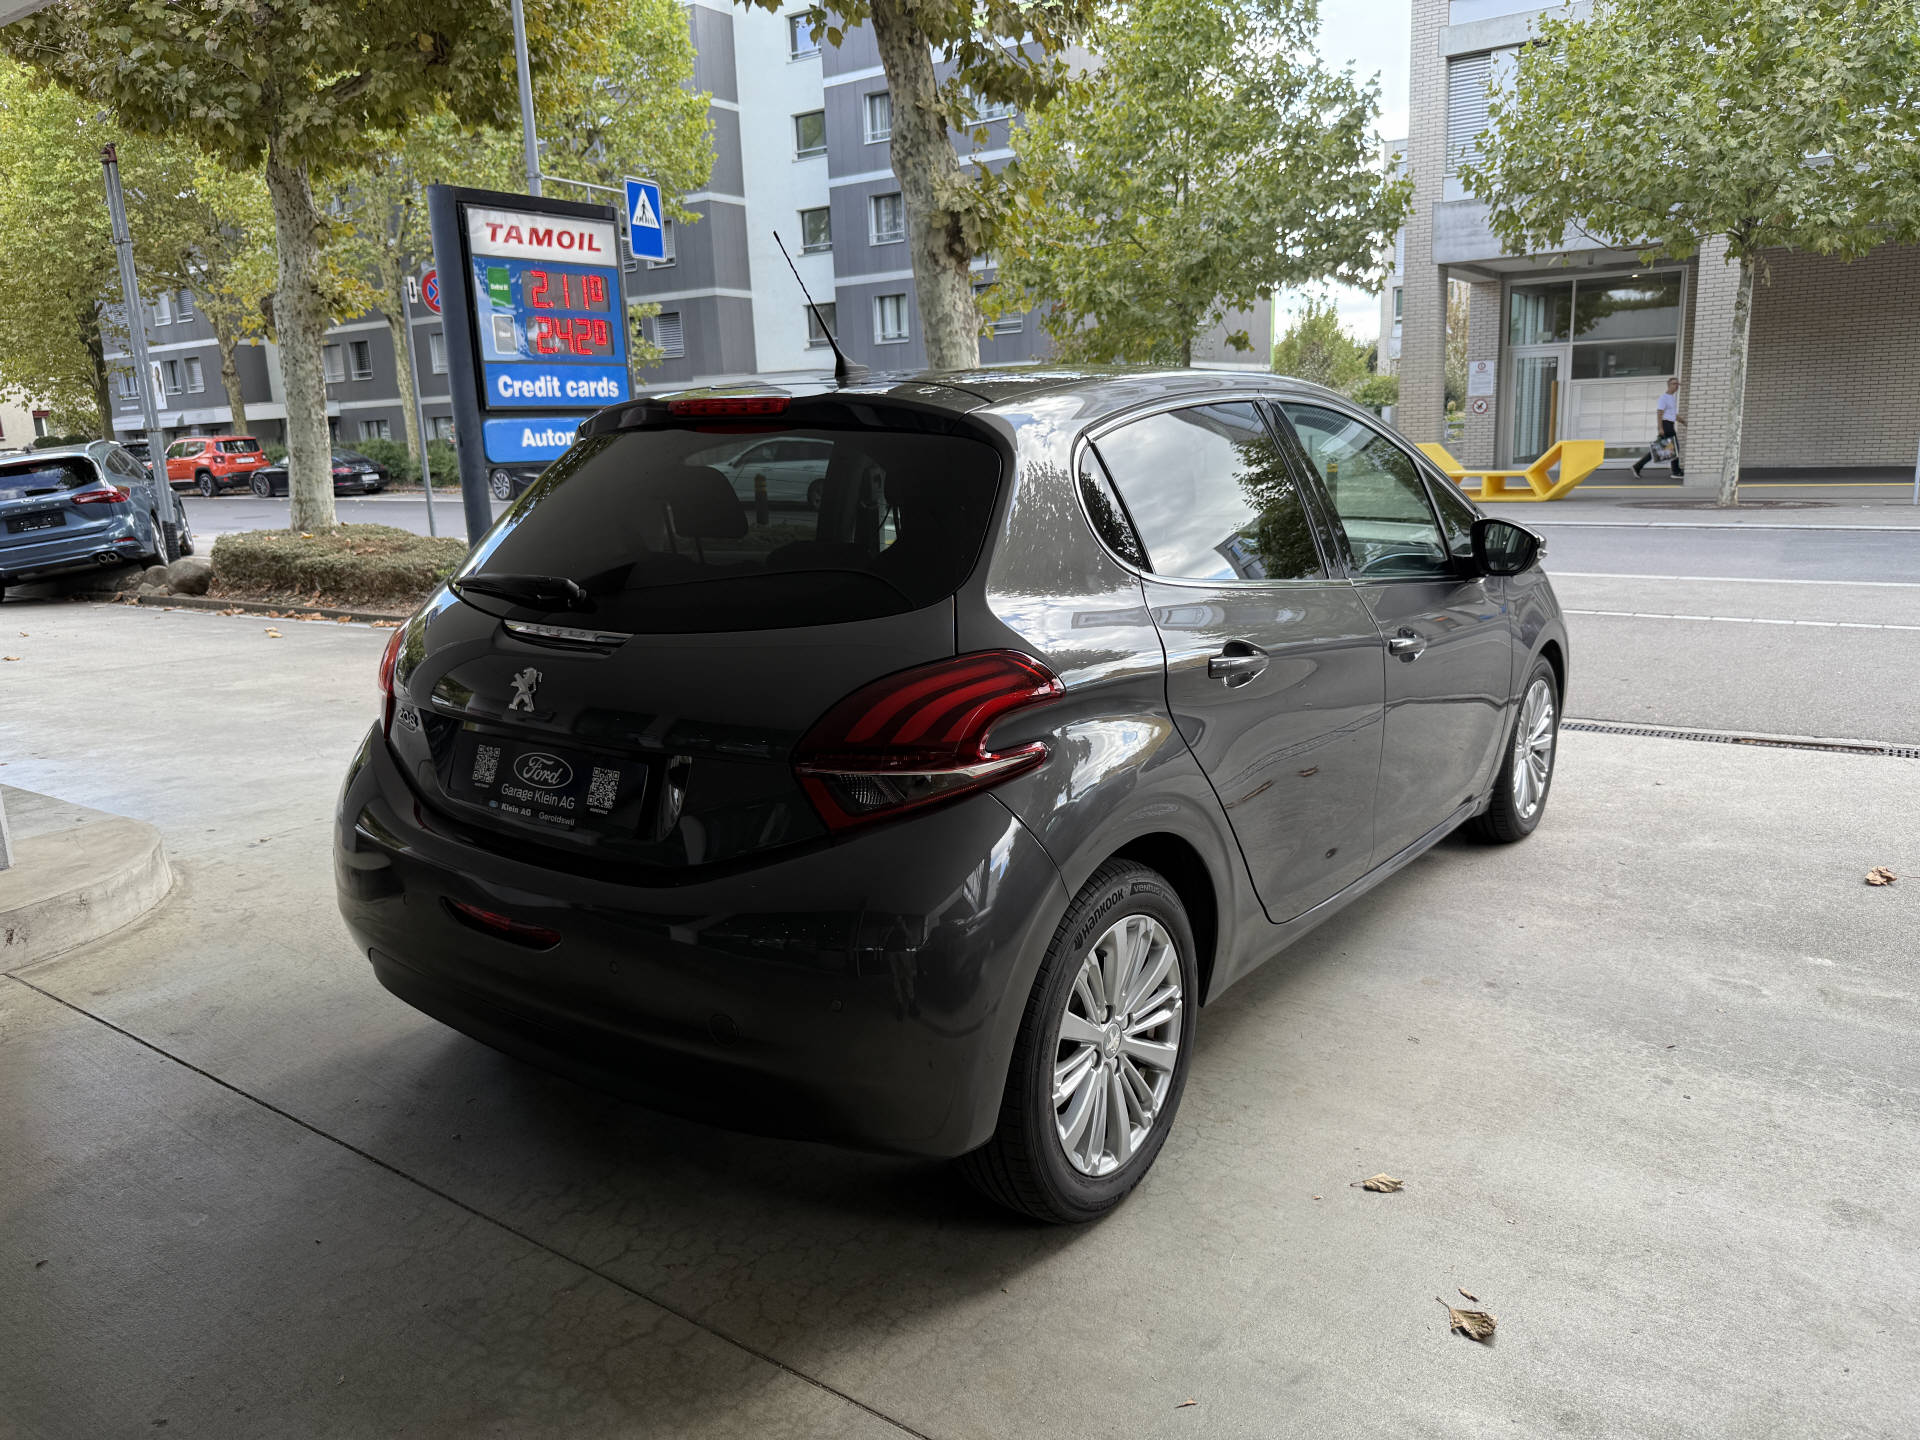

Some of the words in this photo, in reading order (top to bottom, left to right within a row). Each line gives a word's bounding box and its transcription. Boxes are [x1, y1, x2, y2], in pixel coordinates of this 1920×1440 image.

[485, 222, 602, 252] TAMOIL
[498, 375, 562, 398] Credit
[566, 376, 619, 398] cards
[398, 708, 418, 728] 208
[522, 756, 564, 785] Ford
[501, 783, 533, 801] Garage
[534, 790, 558, 806] Klein
[559, 796, 575, 809] AG
[501, 802, 519, 814] Klein
[520, 807, 532, 816] AG
